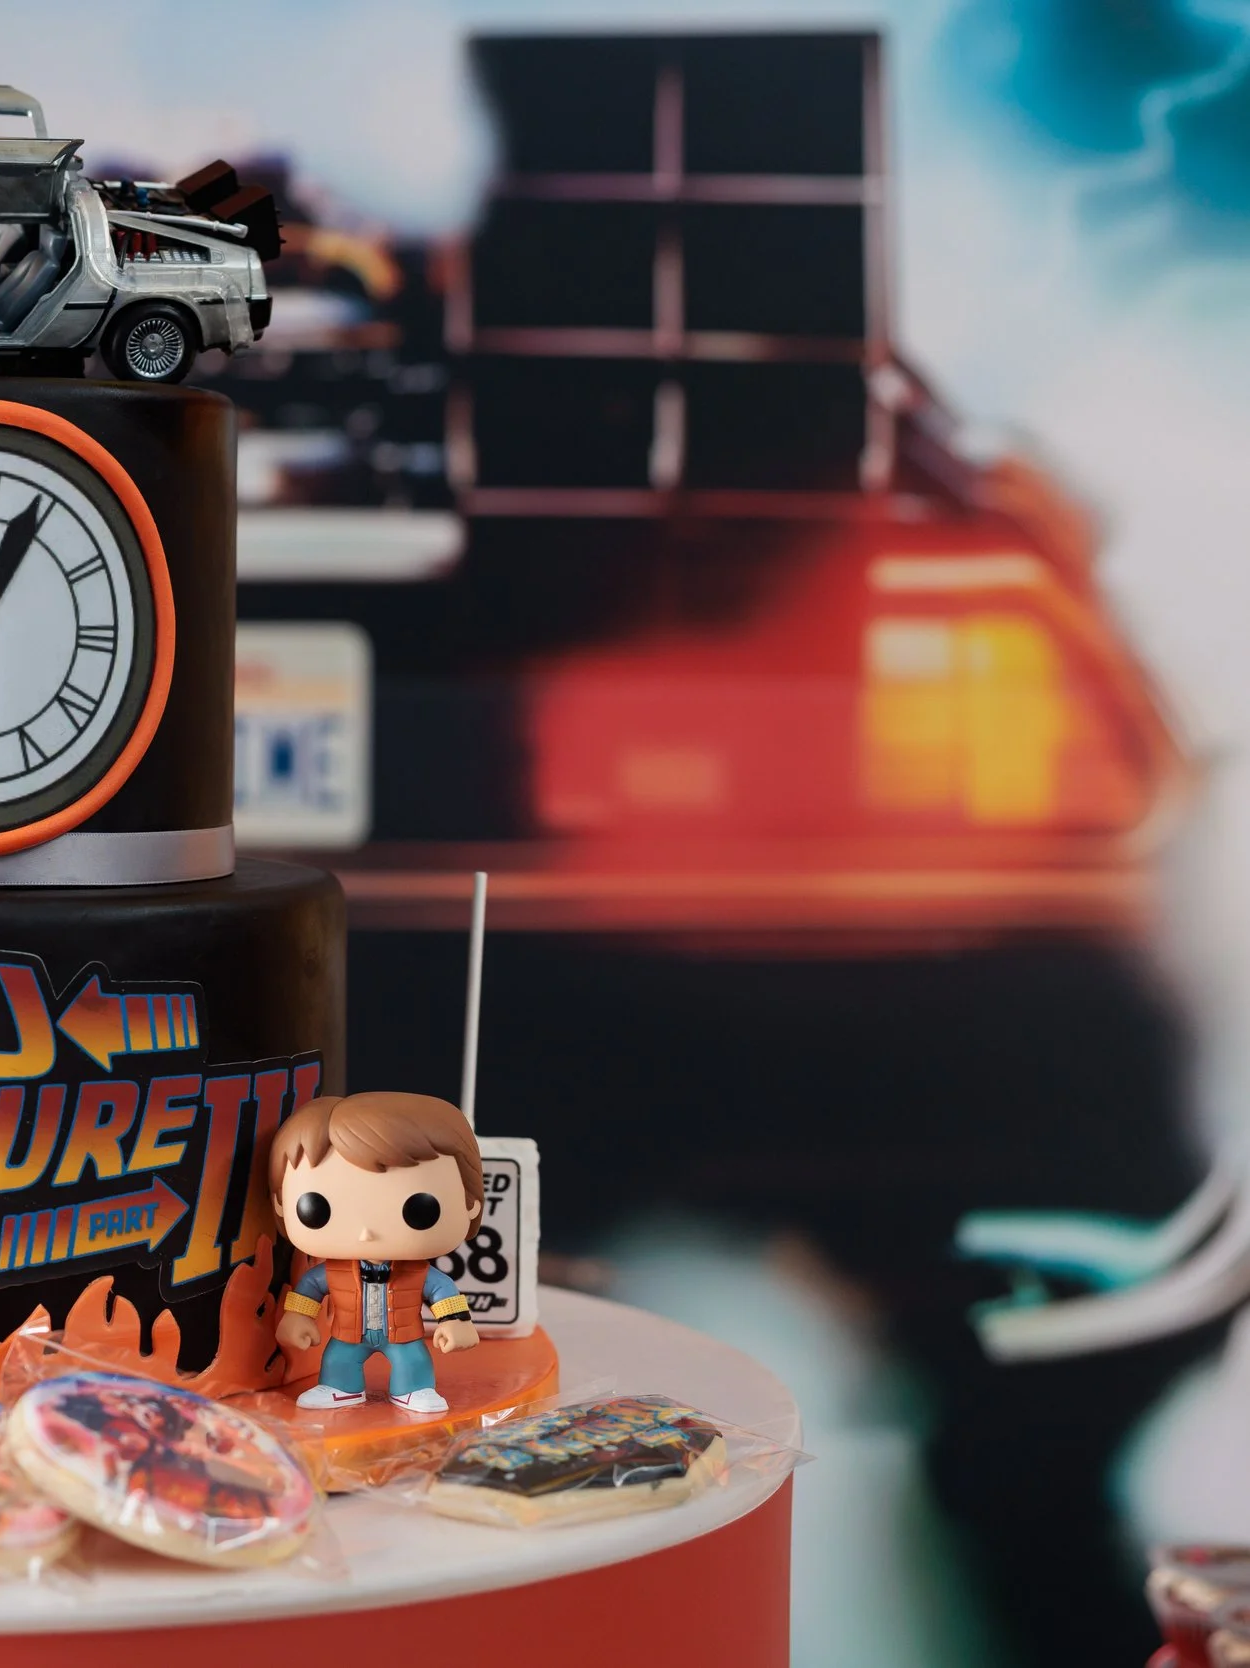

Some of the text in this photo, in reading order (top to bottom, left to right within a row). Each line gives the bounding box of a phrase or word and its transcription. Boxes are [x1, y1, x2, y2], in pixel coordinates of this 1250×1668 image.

[65, 553, 106, 585] II
[77, 624, 117, 654] III
[54, 681, 100, 733] IV
[17, 726, 50, 773] V
[88, 1201, 160, 1241] PART
